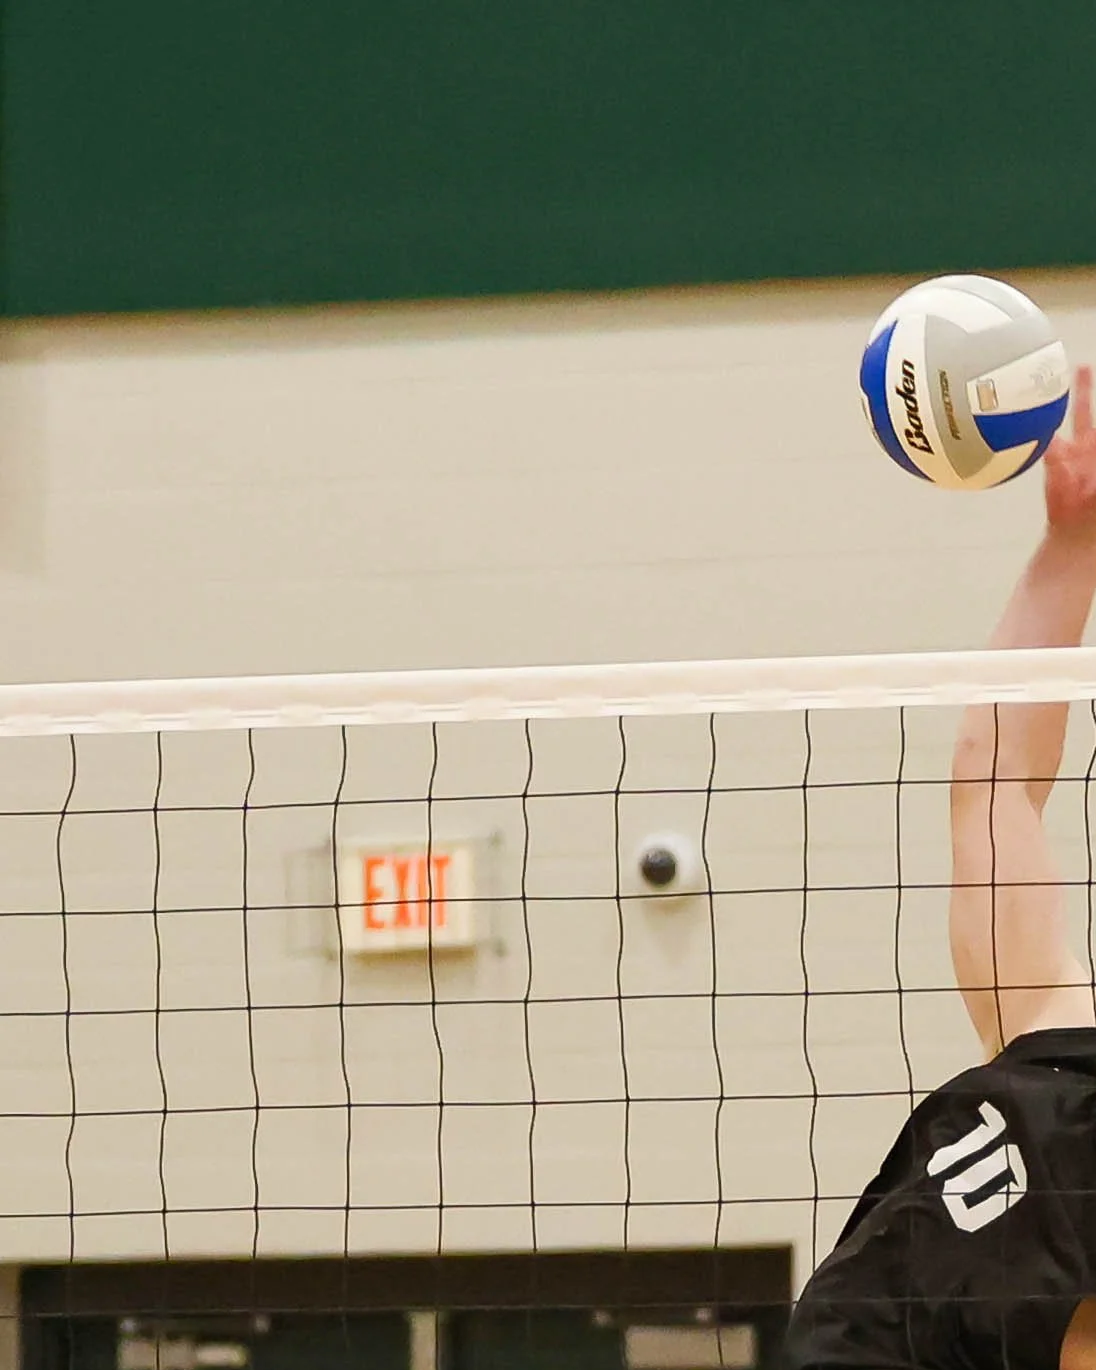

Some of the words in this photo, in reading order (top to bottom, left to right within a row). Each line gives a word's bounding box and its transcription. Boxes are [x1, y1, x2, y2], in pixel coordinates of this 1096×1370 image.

[895, 359, 935, 455] Baden
[363, 854, 451, 930] EXIT
[926, 1100, 1028, 1233] 10
